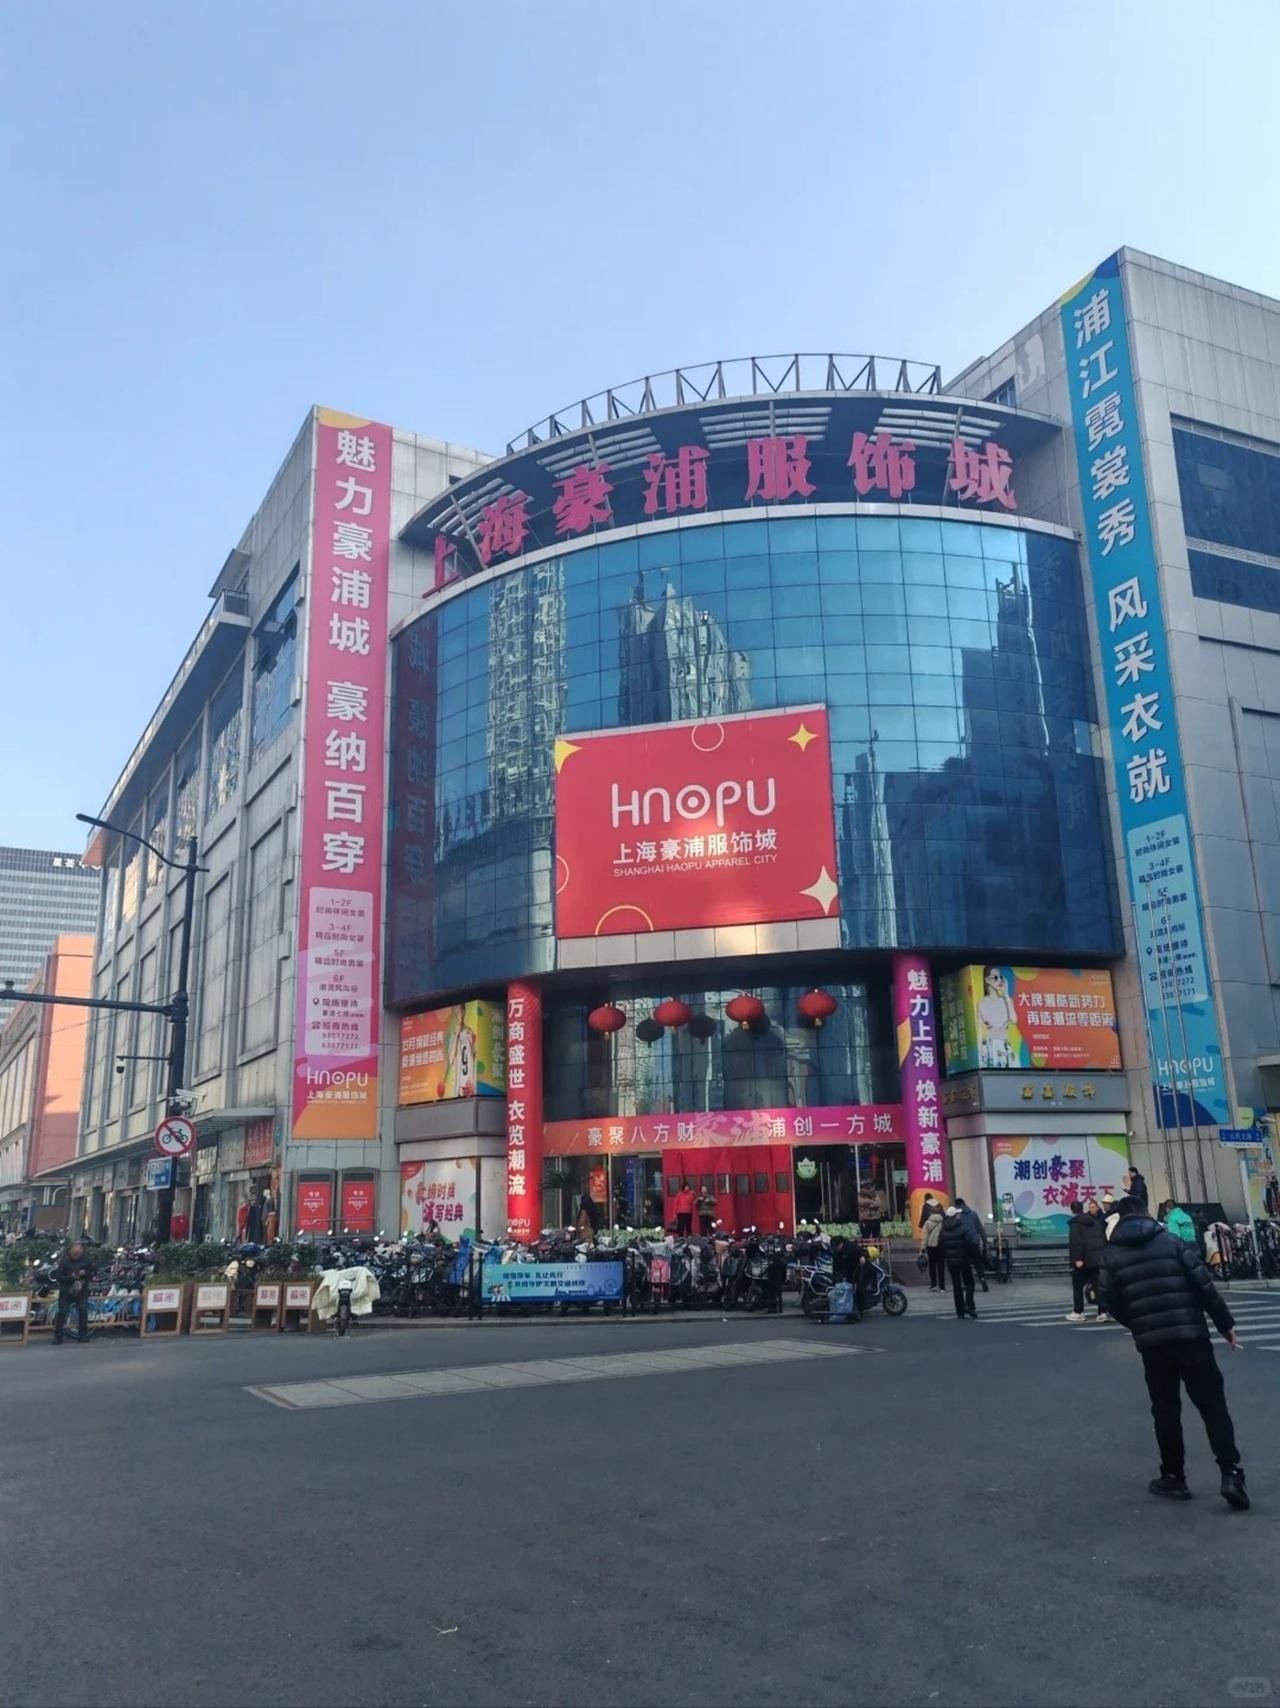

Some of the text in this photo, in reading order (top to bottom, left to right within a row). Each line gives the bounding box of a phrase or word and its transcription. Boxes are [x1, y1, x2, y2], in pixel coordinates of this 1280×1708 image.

[422, 431, 1017, 598] 上海豪浦服饰城
[1073, 288, 1171, 804] 浦江霓裳秀 风采衣就
[322, 430, 376, 873] 魅力豪浦城 豪纳百穿
[613, 829, 777, 865] 上海豪浦服饰城
[614, 853, 777, 877] SHANGHAI HAOPU APPAREL CITY
[508, 998, 526, 1196] 万商盛世 衣览潮流
[588, 1121, 695, 1147] 豪聚八方财
[767, 1112, 893, 1138] 浦创一方城
[907, 968, 943, 1182] 魅力上海 焕新豪浦
